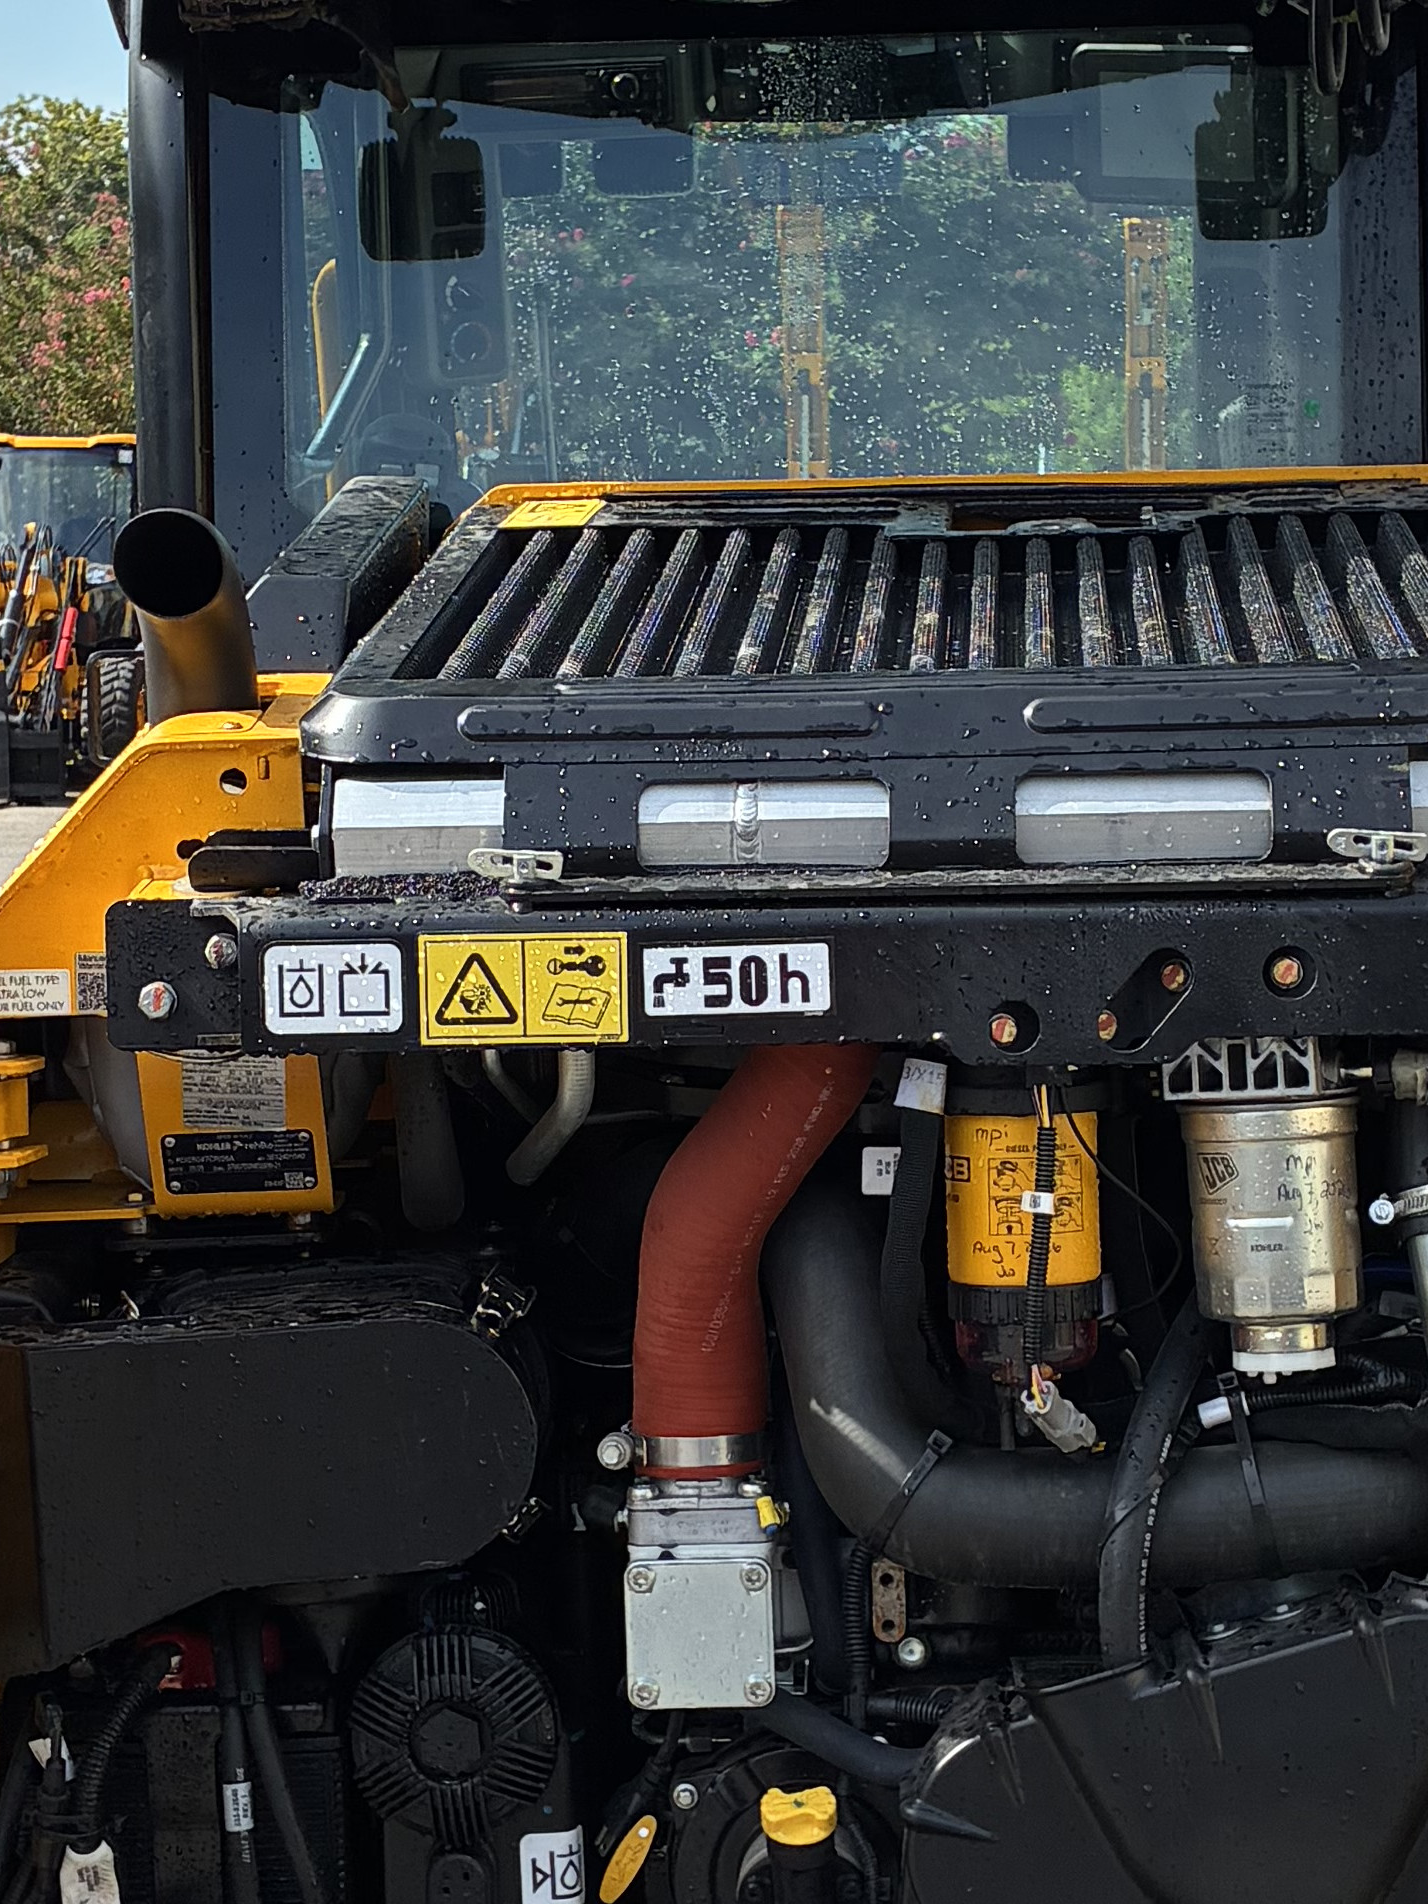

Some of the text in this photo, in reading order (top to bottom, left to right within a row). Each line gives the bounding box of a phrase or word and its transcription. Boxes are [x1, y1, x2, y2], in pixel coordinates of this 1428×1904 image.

[9, 975, 32, 987] FUEL
[21, 989, 47, 999] LOW
[11, 1001, 35, 1012] FUEL
[36, 1000, 66, 1012] ONLY
[1201, 1156, 1235, 1190] JCB
[1277, 1183, 1303, 1212] Aug
[972, 1240, 1004, 1264] Aug
[1250, 1243, 1284, 1253] KOHLER
